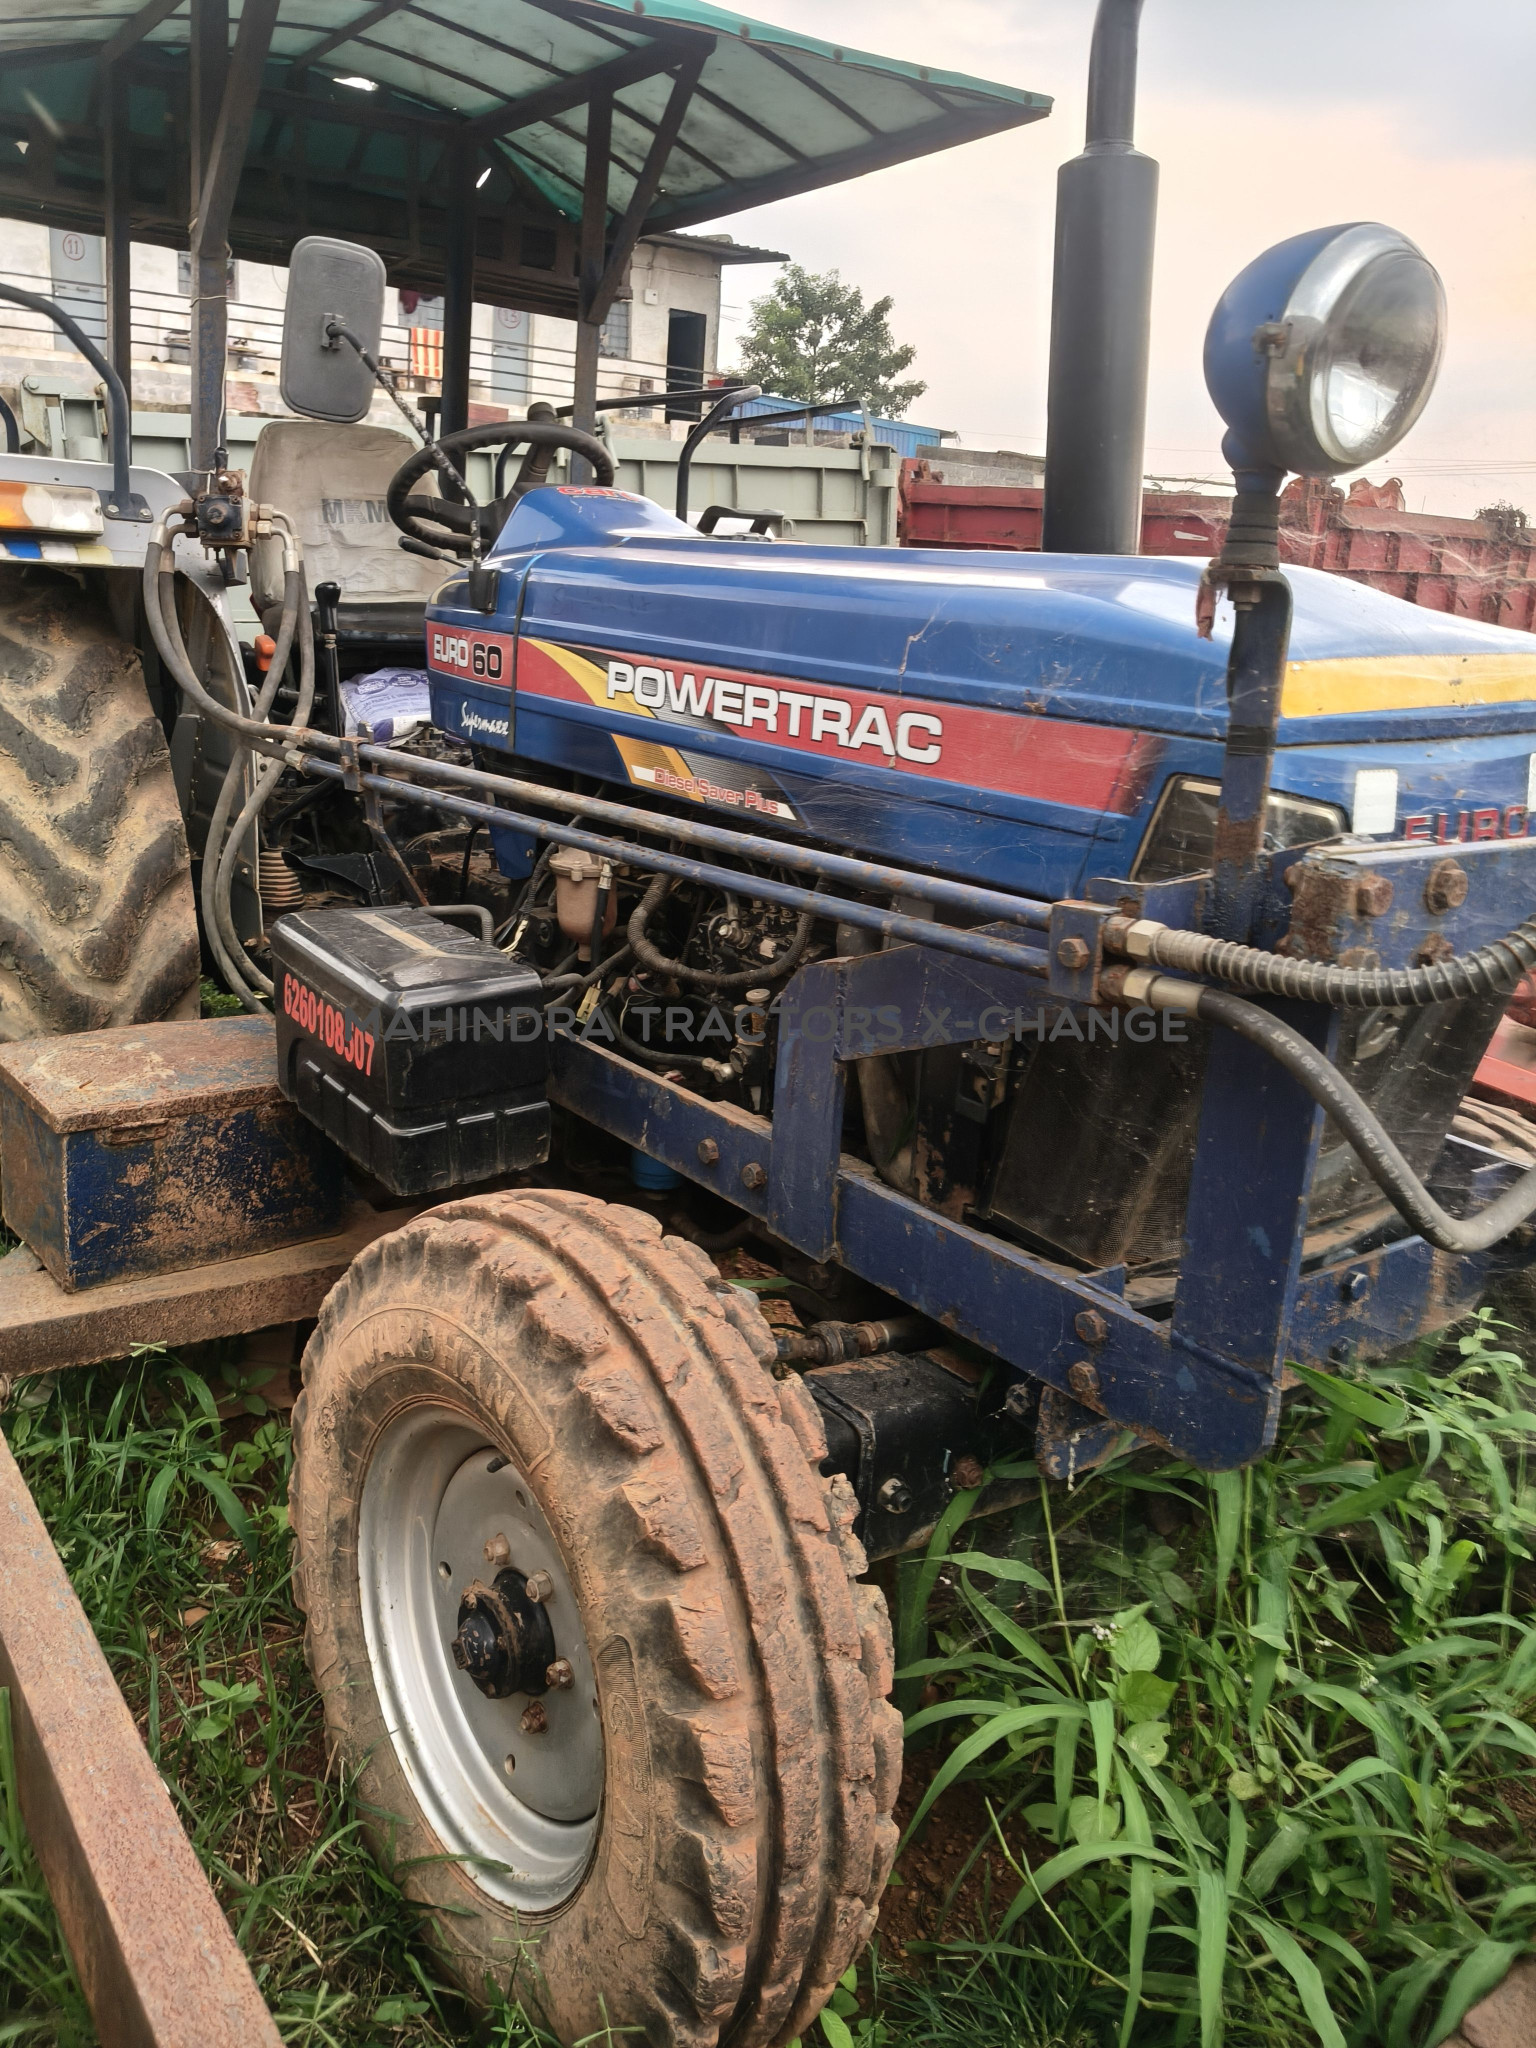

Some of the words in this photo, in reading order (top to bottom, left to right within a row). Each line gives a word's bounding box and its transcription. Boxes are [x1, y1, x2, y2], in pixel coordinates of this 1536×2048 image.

[67, 239, 79, 255] 11
[433, 633, 469, 668] EURO
[472, 641, 503, 680] 60
[607, 661, 943, 764] POWERTRAC
[653, 766, 697, 794] Diesel
[698, 777, 744, 806] Saver
[744, 789, 779, 815] Plus
[1405, 804, 1529, 846] EURO
